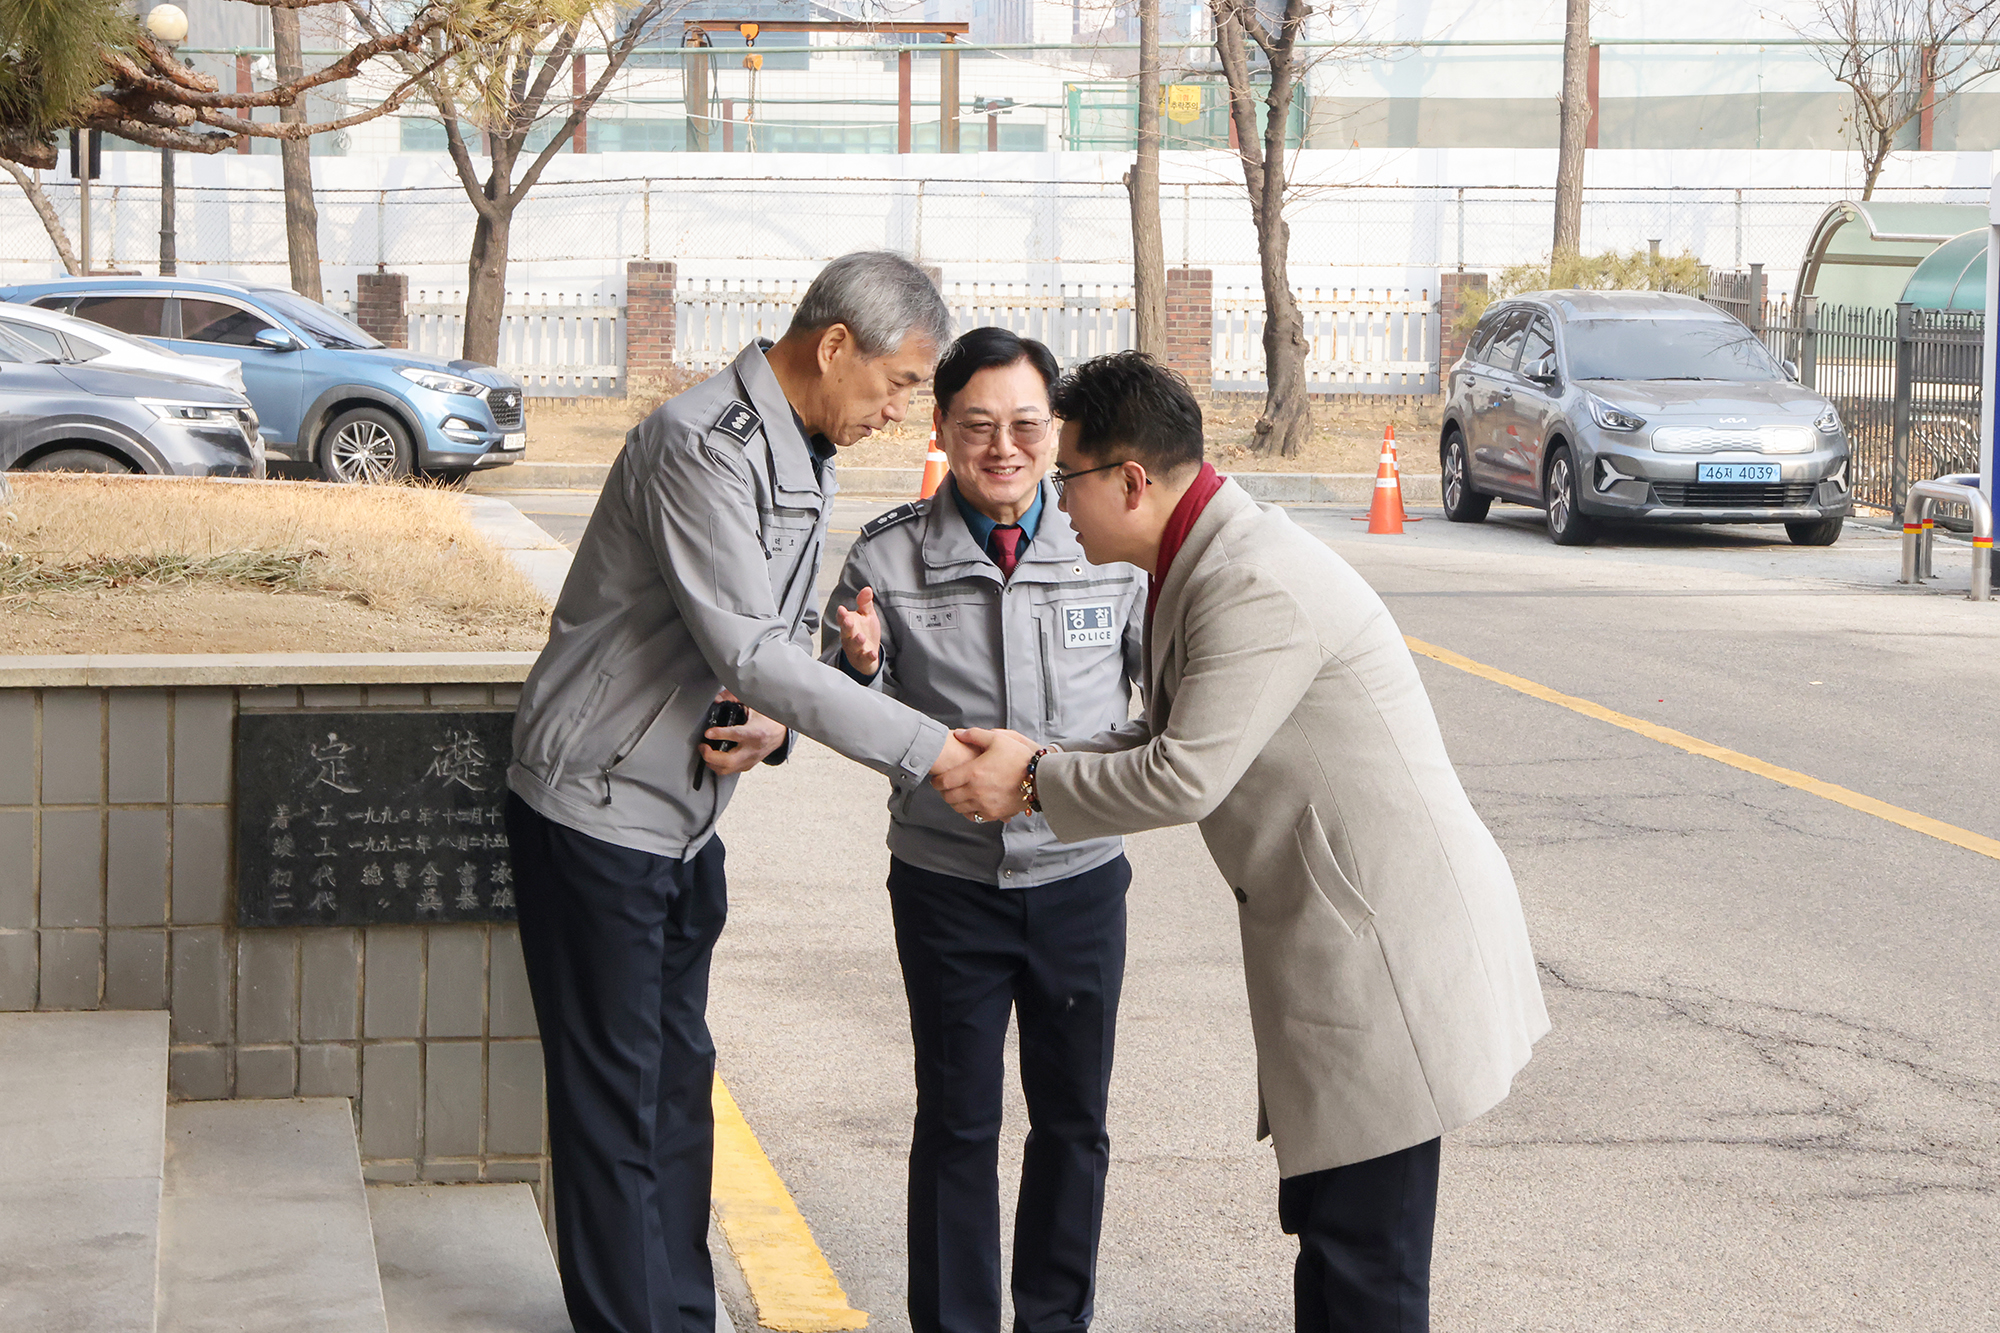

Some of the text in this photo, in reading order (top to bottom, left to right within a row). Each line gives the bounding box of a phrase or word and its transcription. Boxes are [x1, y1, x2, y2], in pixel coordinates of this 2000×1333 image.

[1171, 101, 1199, 110] 추락주의
[1706, 466, 1773, 480] 46저 4039
[1069, 608, 1110, 630] 경찰
[1070, 631, 1111, 642] POLICE
